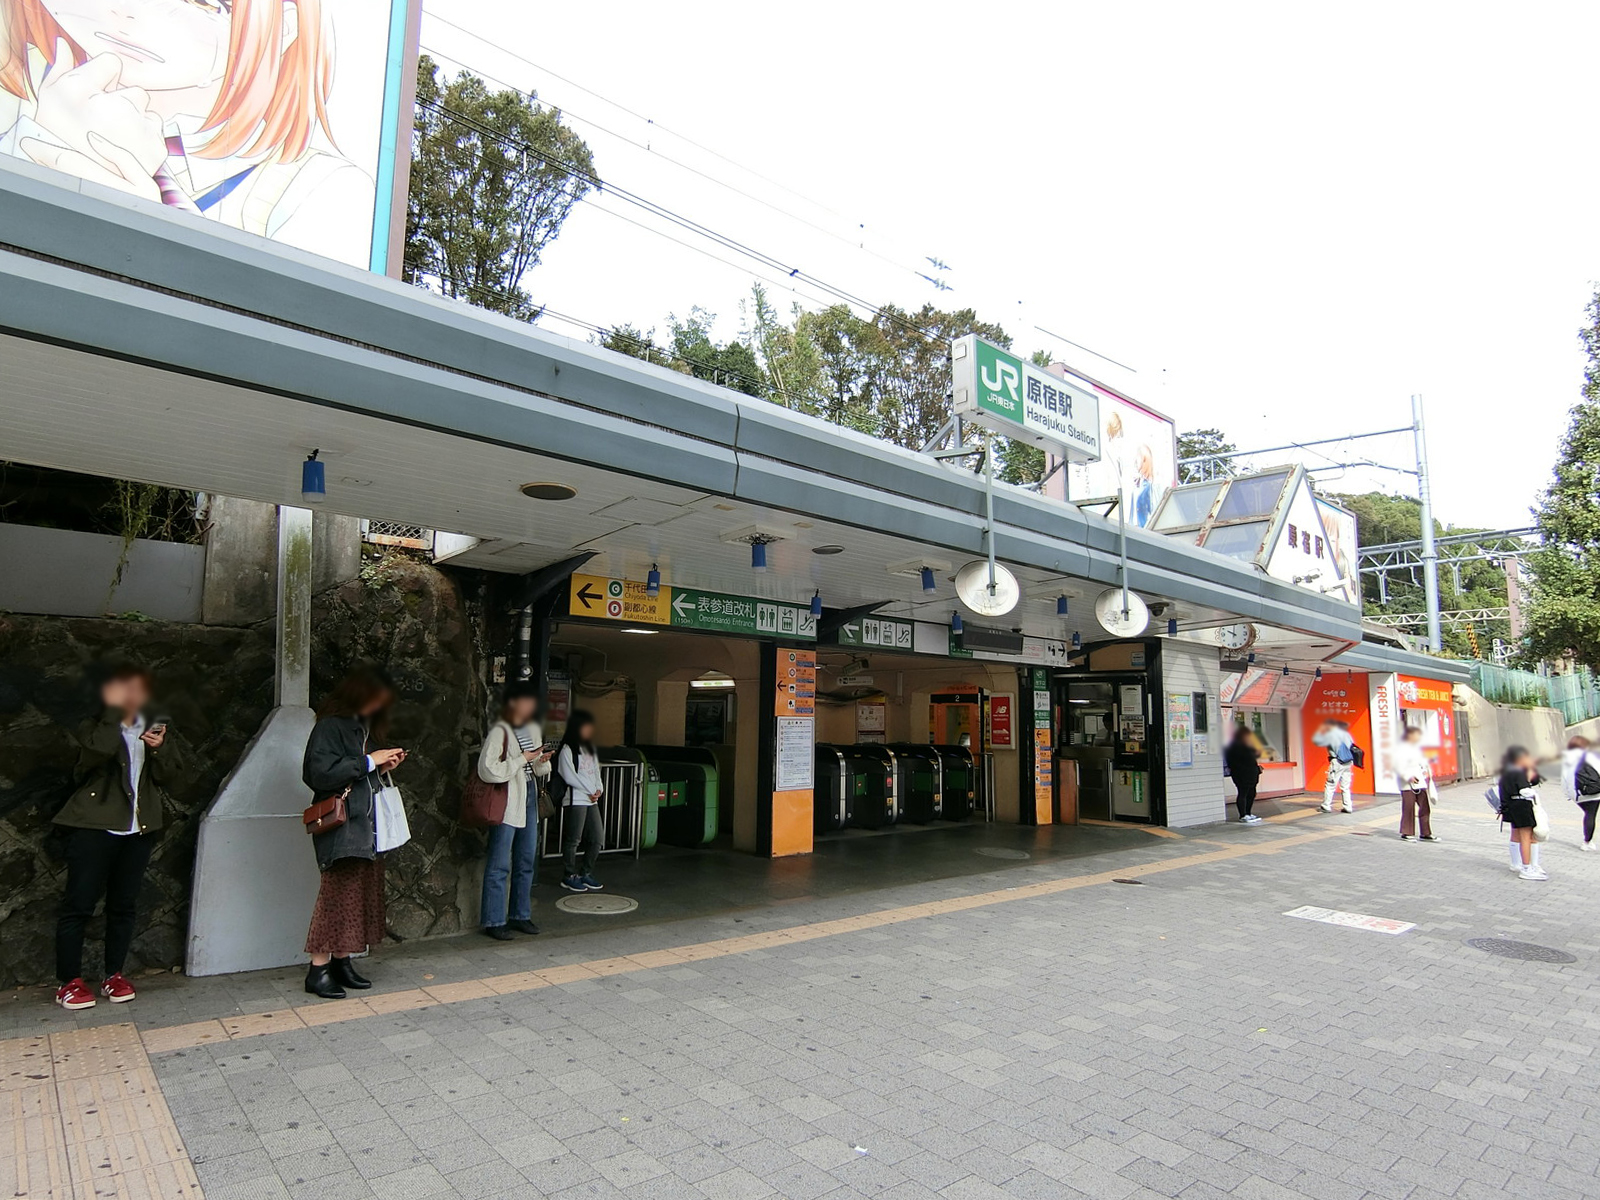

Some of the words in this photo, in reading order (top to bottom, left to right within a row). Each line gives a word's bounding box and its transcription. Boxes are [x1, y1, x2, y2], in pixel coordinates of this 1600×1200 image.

[981, 358, 1019, 401] JR
[1026, 375, 1074, 420] 原宿駅
[1027, 405, 1066, 434] Harajuku
[1067, 424, 1096, 447] Station
[1288, 523, 1324, 559] 原宿駅
[624, 602, 657, 614] 副都心線
[624, 612, 653, 621] Fukutoshin
[698, 596, 756, 619] 表参道改札
[732, 618, 755, 628] Entrance
[1377, 686, 1389, 717] FRESH
